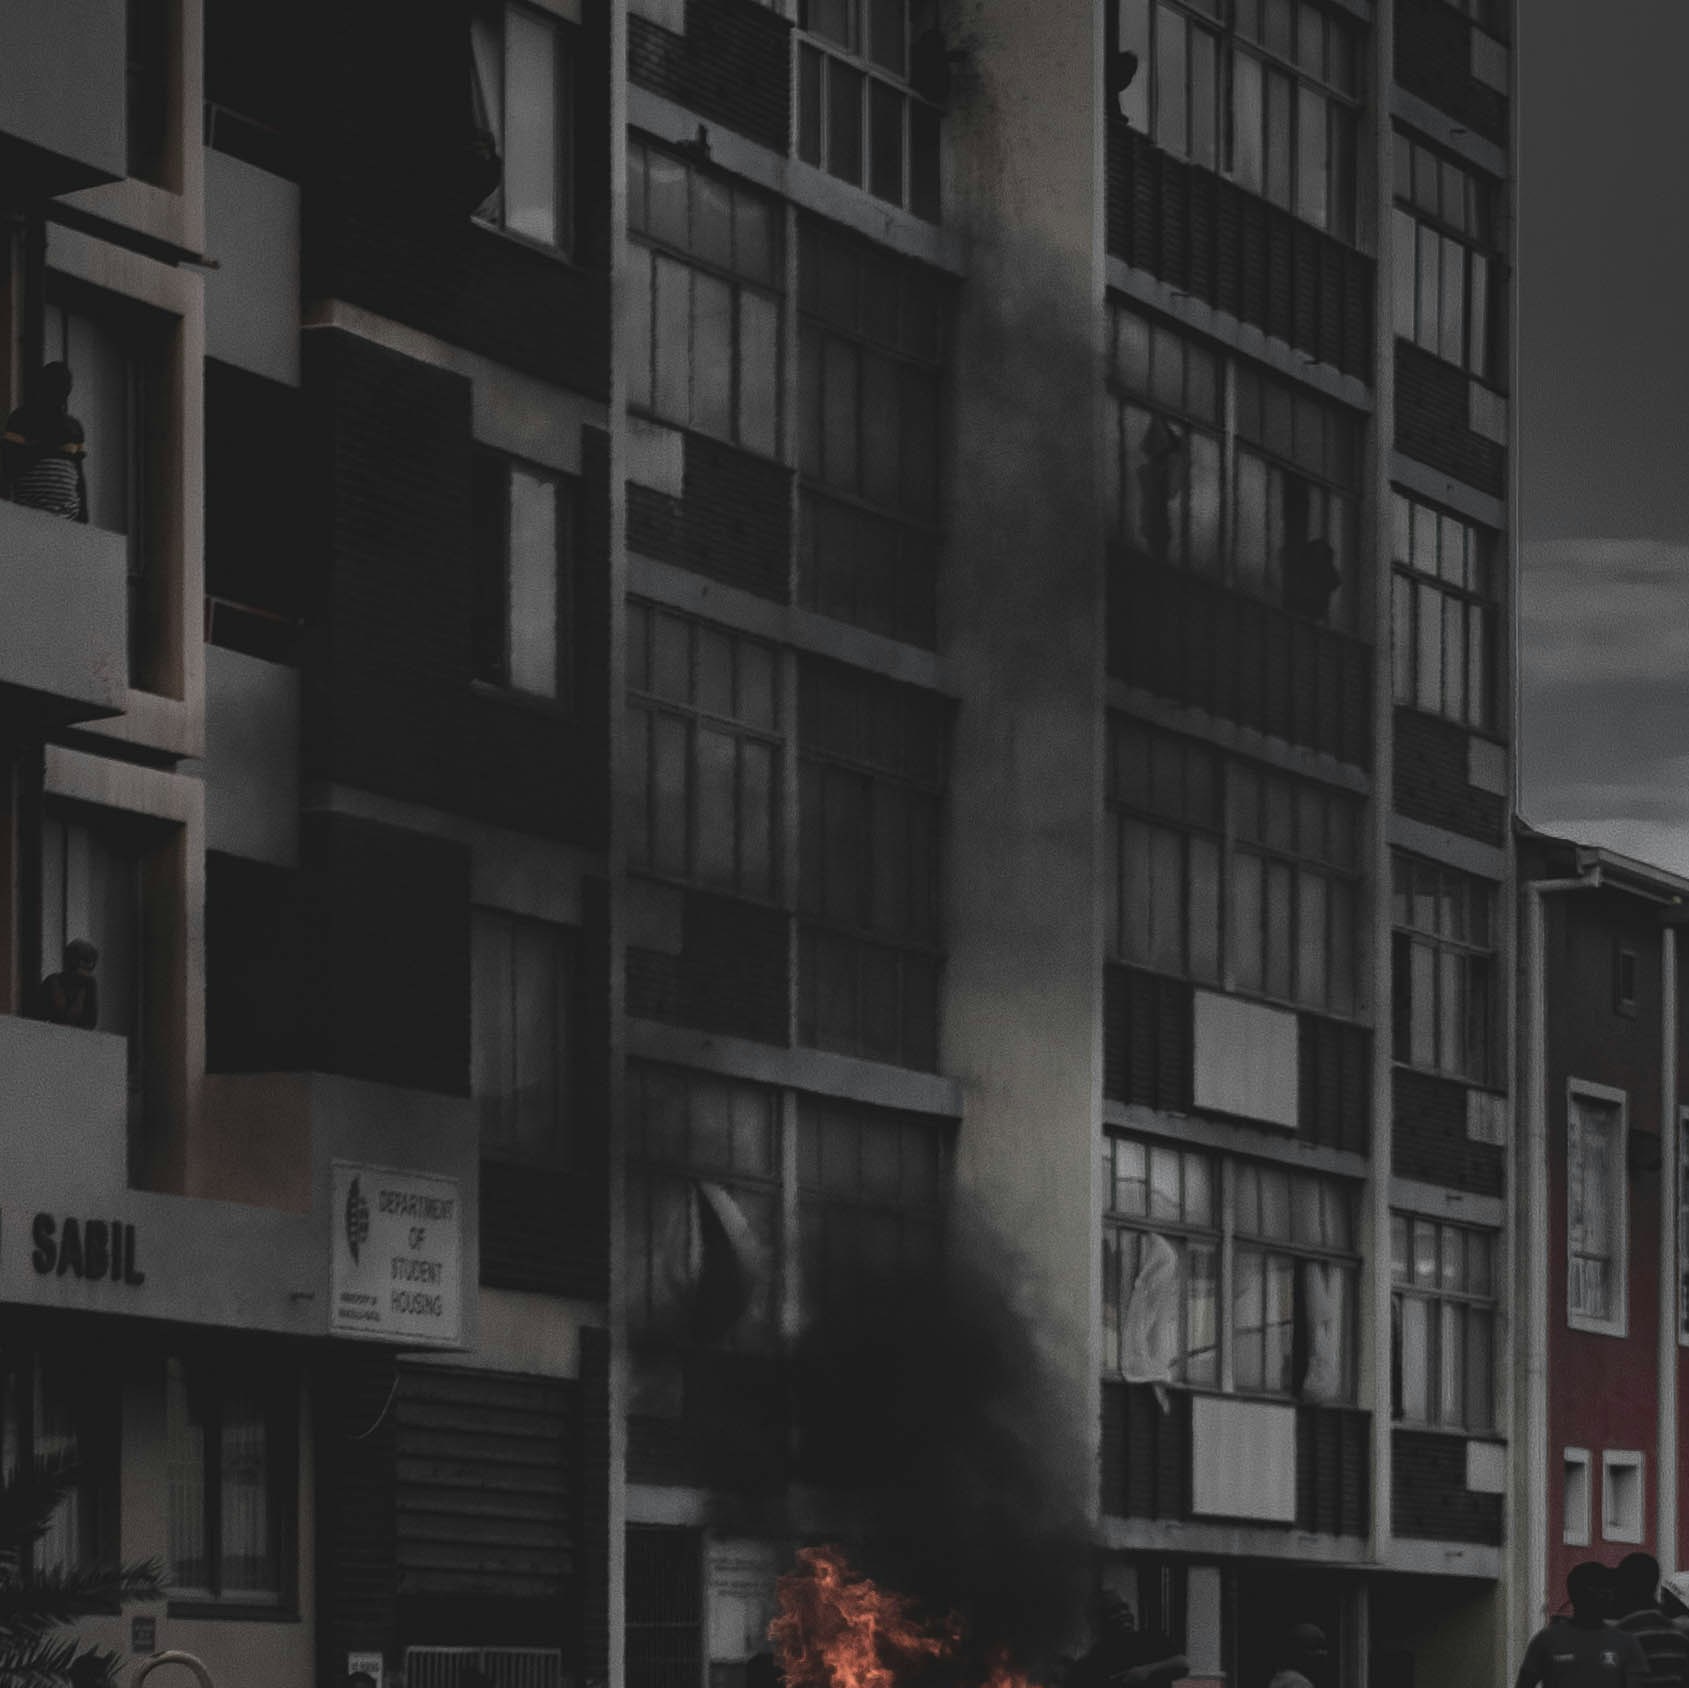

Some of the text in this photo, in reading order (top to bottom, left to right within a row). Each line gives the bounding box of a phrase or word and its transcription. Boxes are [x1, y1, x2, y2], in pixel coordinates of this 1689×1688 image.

[378, 1189, 454, 1221] DEPARTMENT
[32, 1212, 146, 1287] SABIL
[408, 1226, 426, 1252] OF
[391, 1256, 443, 1284] STUDENT
[391, 1290, 443, 1317] HOUSING
